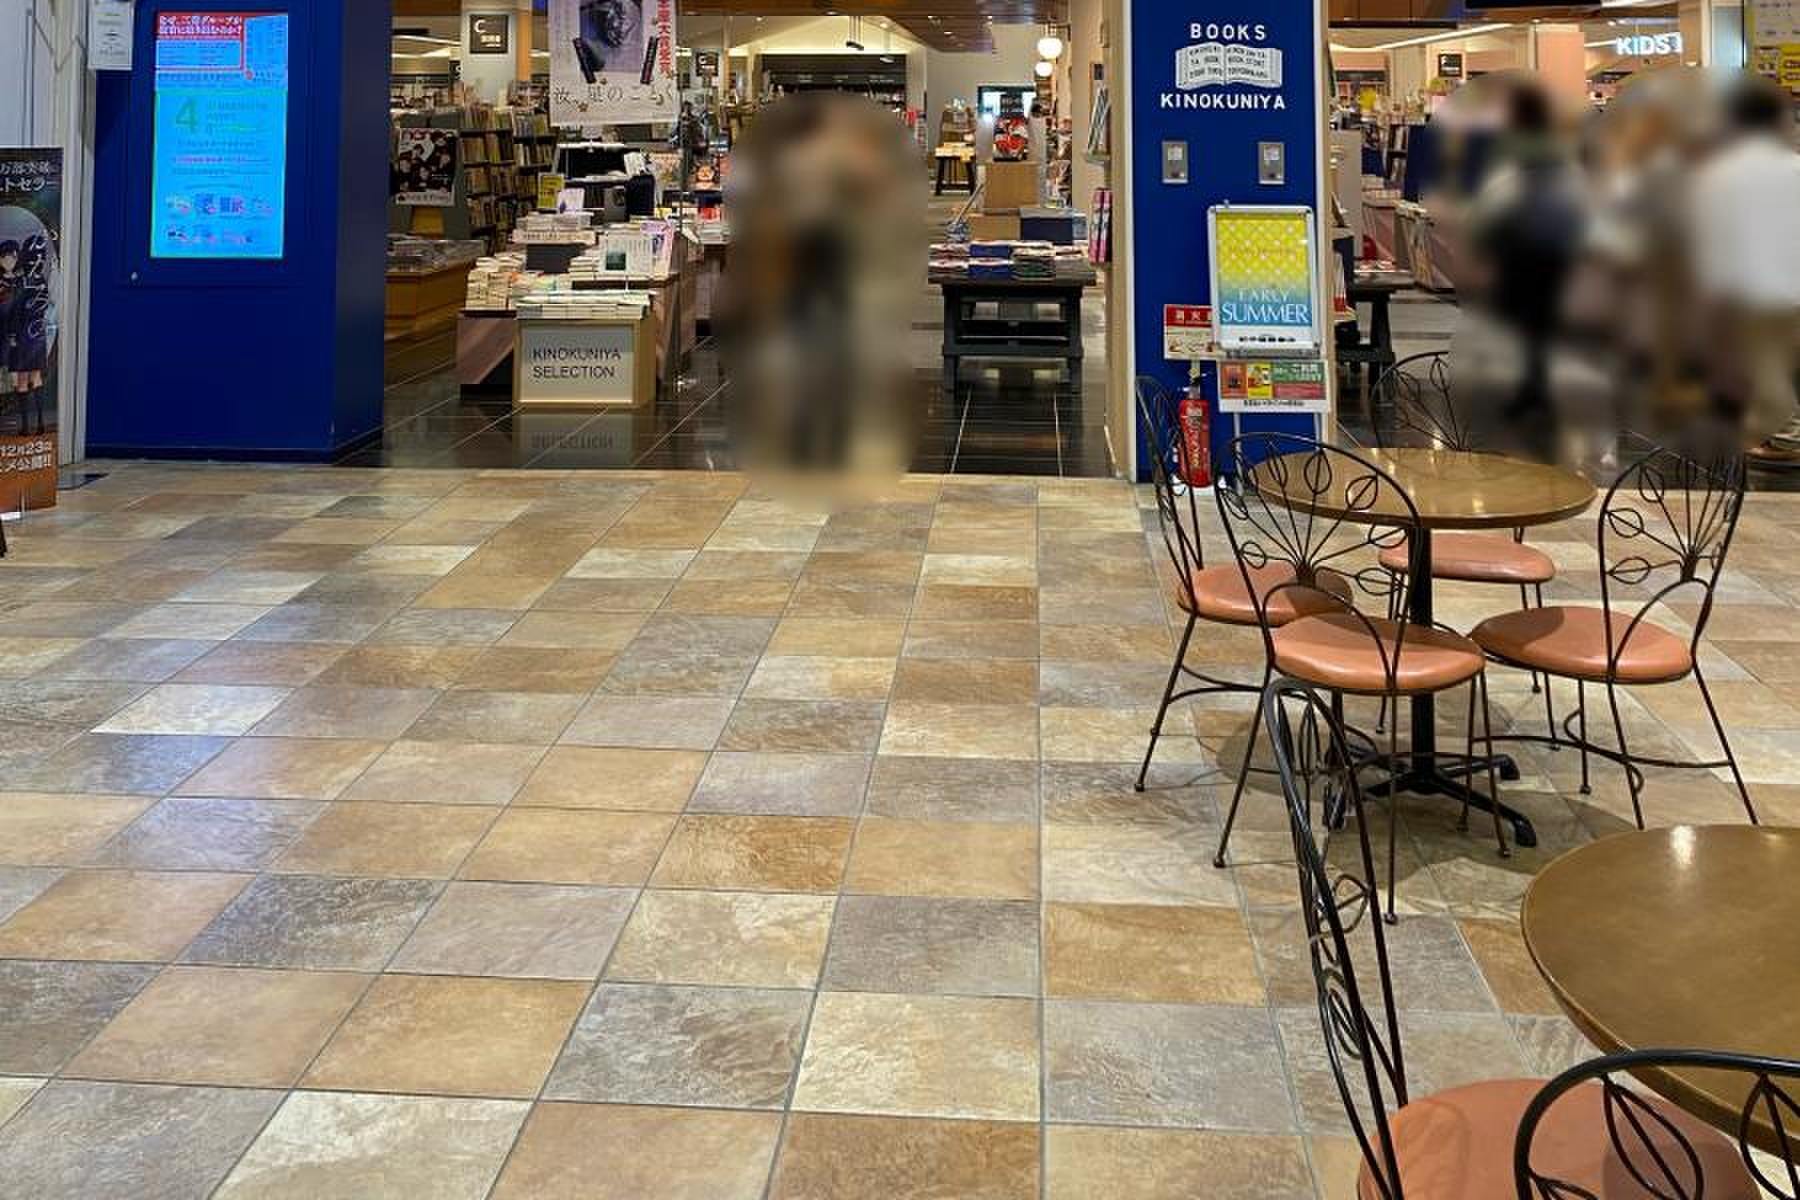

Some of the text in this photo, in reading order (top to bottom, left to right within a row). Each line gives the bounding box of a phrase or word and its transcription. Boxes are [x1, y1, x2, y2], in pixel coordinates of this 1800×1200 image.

[1190, 23, 1266, 40] BOOKS
[1161, 93, 1286, 109] KINOKUNIYA
[1221, 303, 1310, 323] SUMMER
[533, 347, 621, 360] KINOKUNIYA
[533, 365, 615, 379] SELECTION
